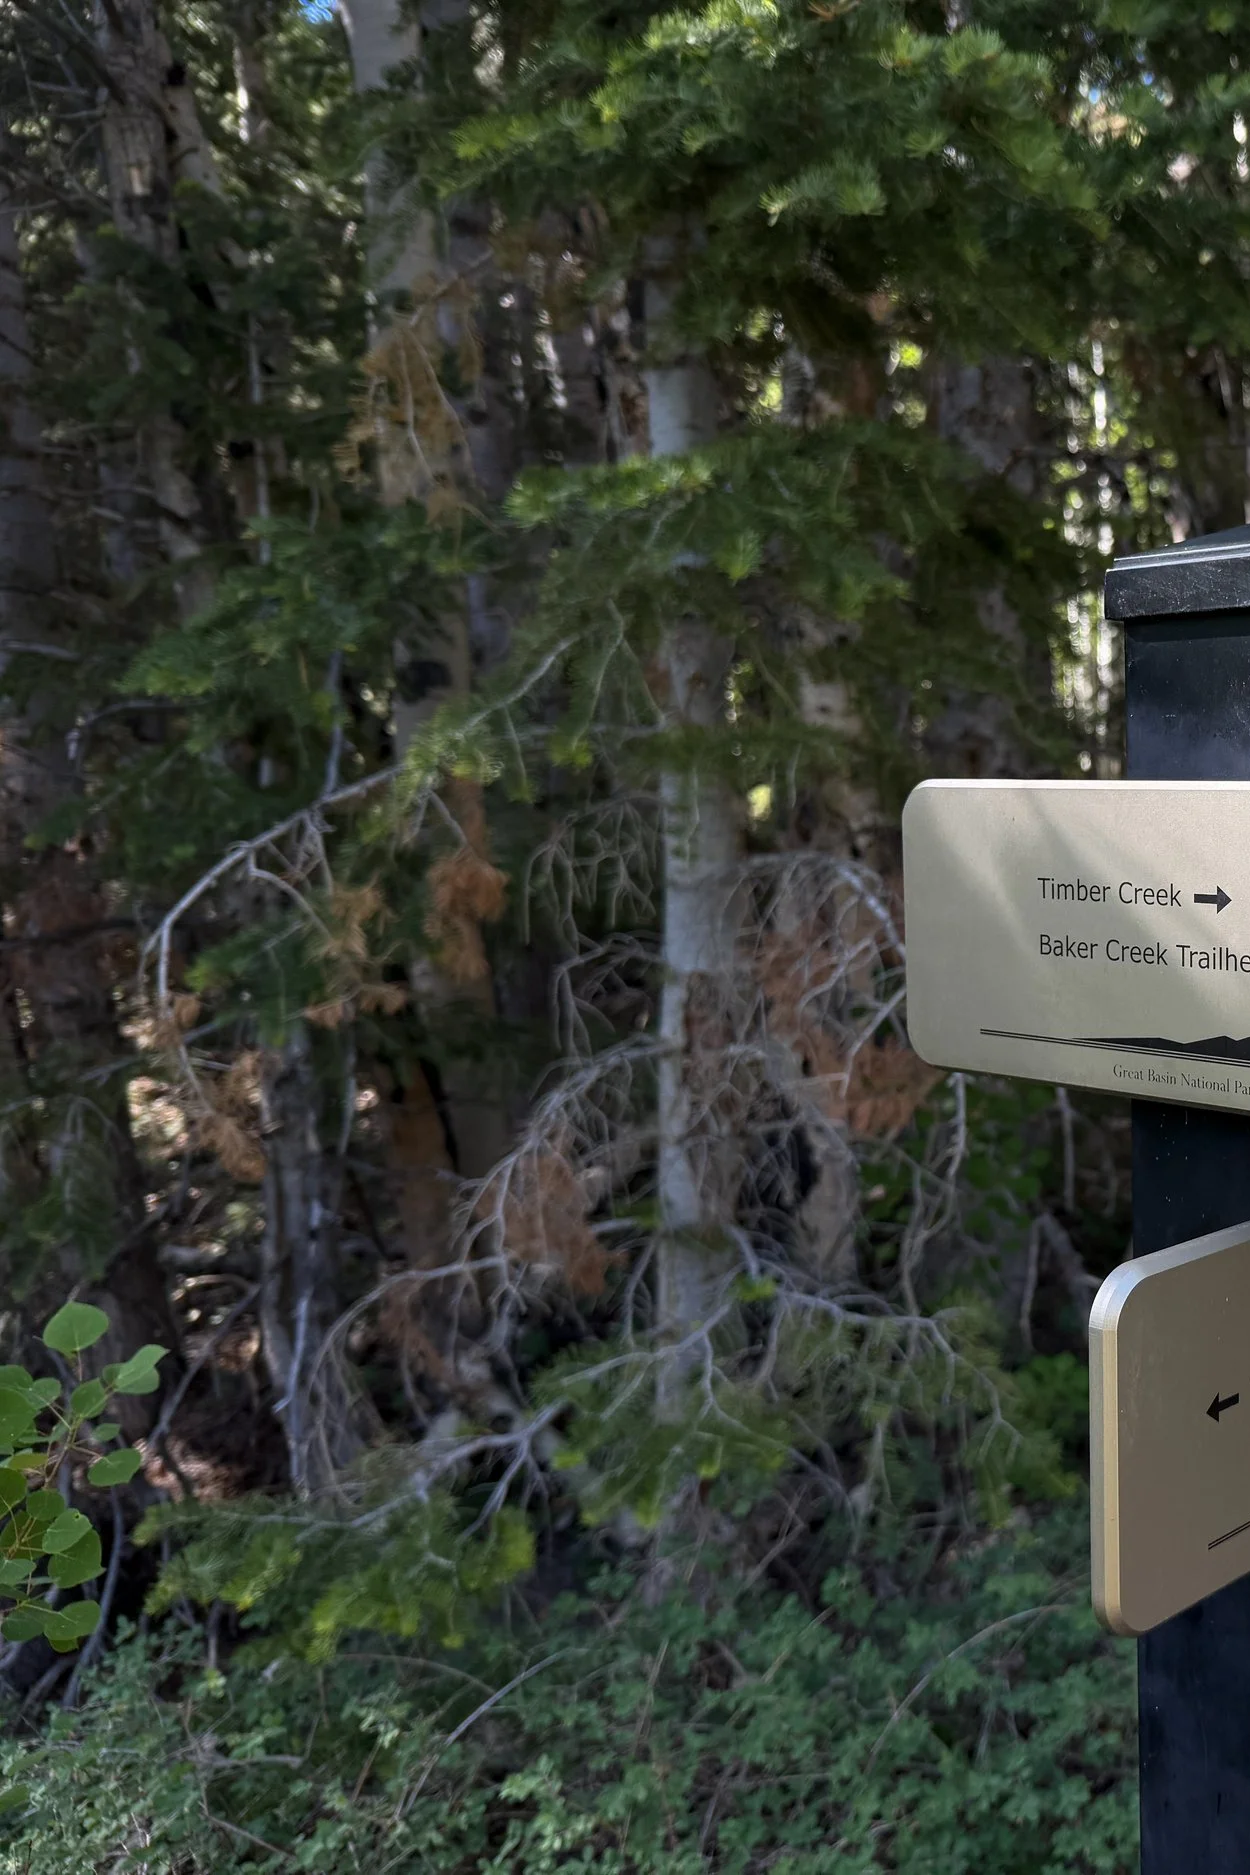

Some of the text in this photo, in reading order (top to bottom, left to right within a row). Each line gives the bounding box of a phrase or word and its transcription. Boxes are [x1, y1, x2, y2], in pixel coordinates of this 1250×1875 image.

[1037, 877, 1182, 907] Timber Creek
[1039, 934, 1098, 960] Baker
[1105, 939, 1168, 966] Creek
[1113, 1063, 1144, 1081] Great
[1148, 1069, 1177, 1085] Basin
[1181, 1073, 1230, 1093] National
